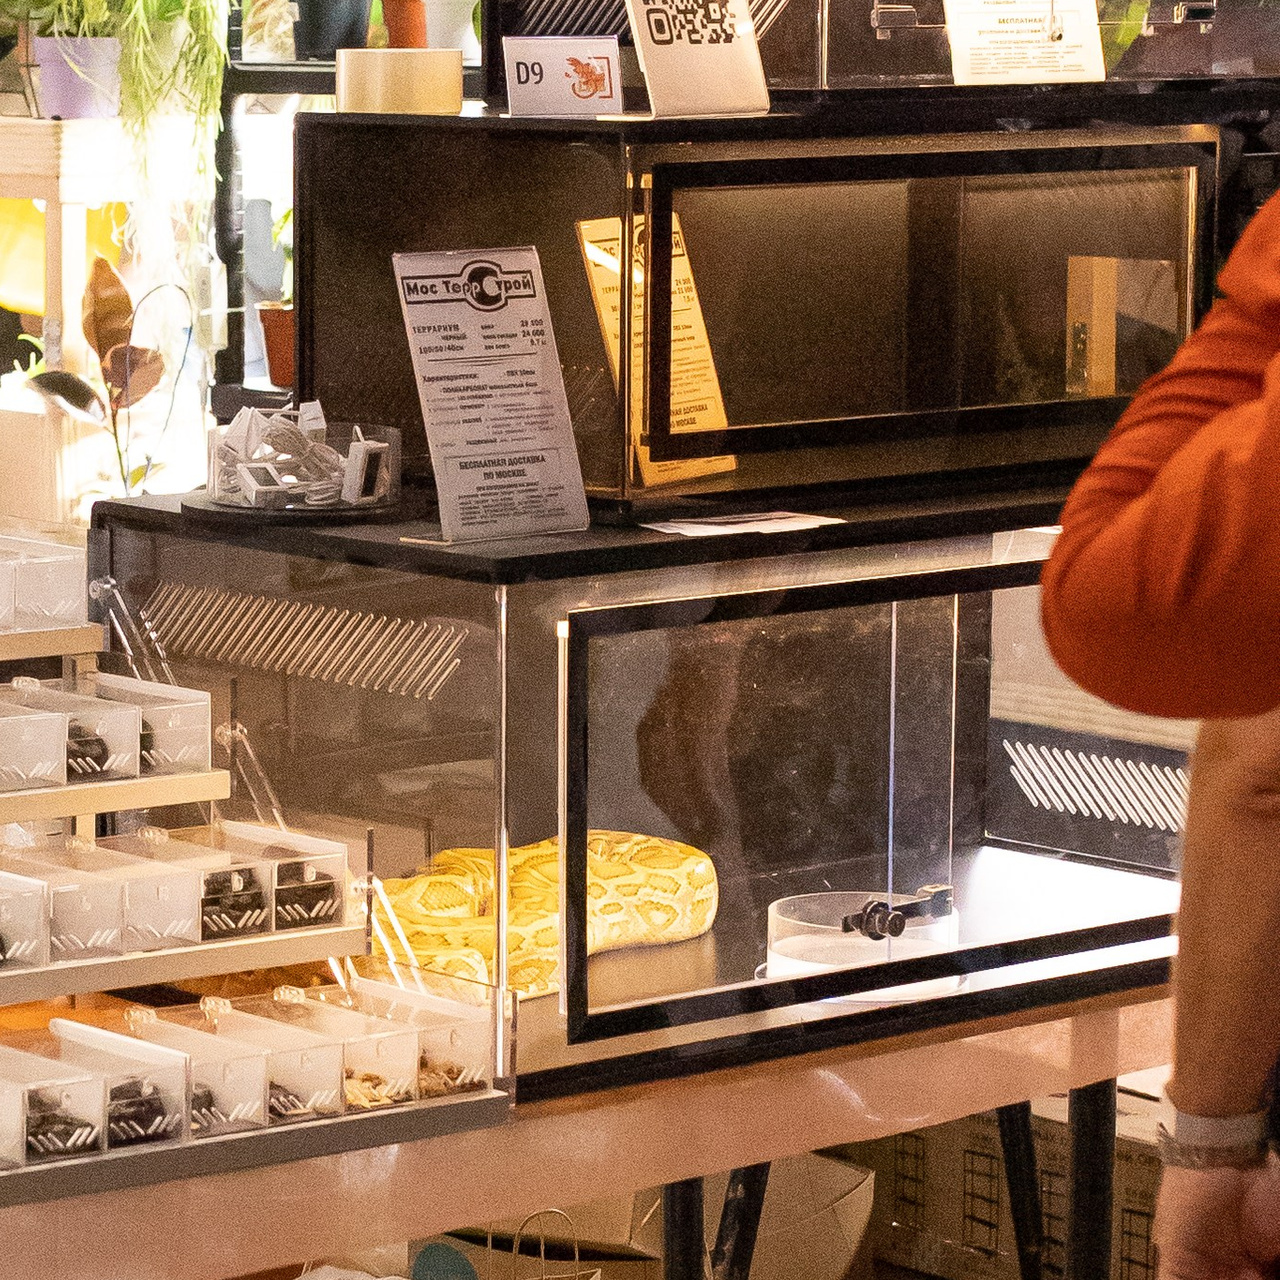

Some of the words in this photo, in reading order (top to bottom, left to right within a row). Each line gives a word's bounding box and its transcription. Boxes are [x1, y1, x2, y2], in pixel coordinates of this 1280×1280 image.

[516, 61, 544, 85] D9
[406, 281, 438, 297] Мос
[459, 458, 507, 470] БЕСПЛАТНАЯ
[508, 455, 547, 467] ДОСТАВКА
